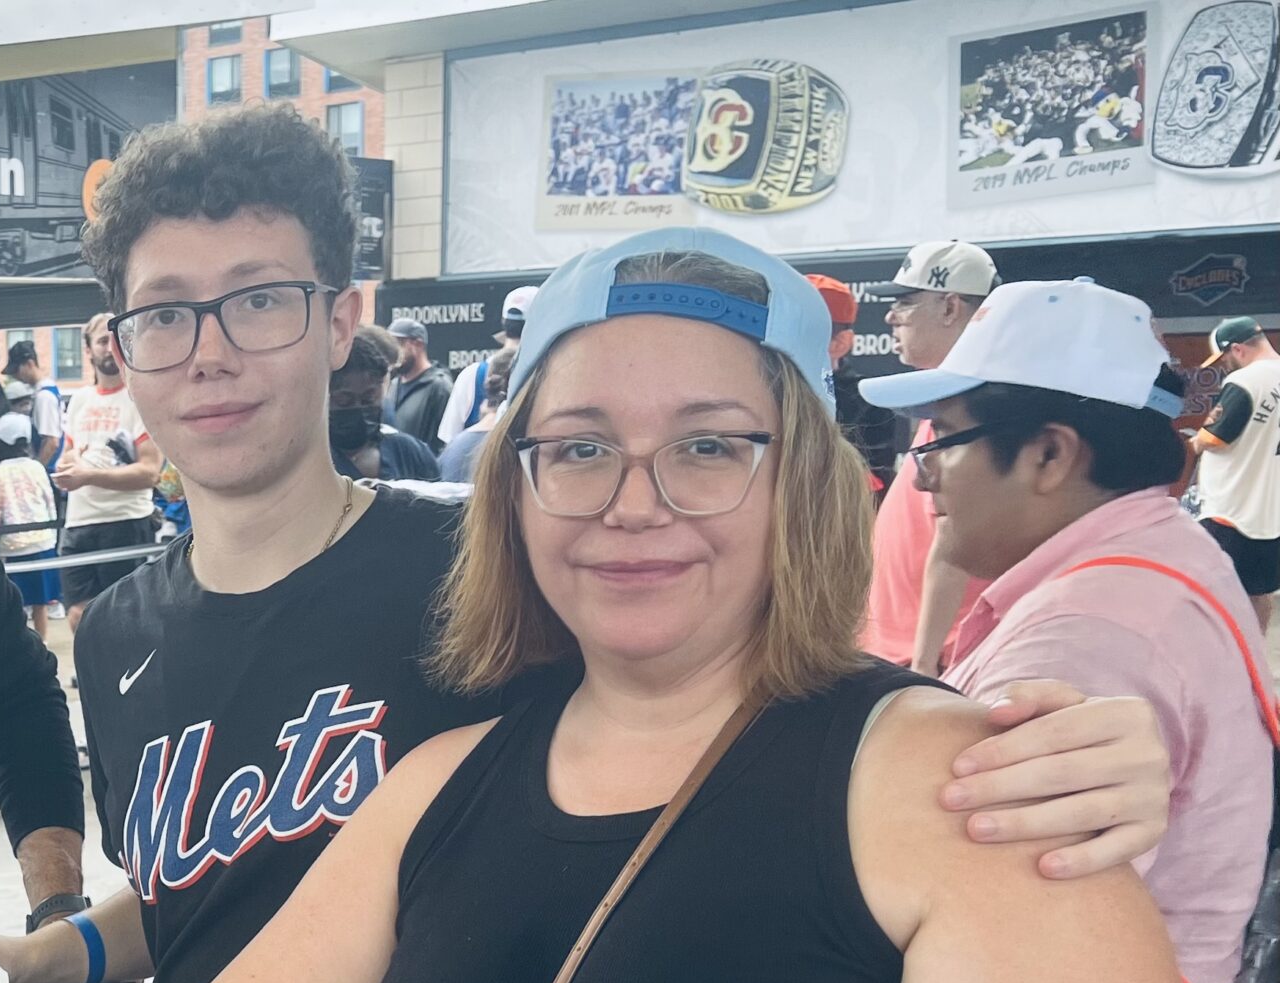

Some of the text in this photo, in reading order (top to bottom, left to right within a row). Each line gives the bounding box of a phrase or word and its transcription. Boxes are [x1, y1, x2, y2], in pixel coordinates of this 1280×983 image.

[793, 147, 819, 194] NEW
[807, 83, 828, 144] YORK
[972, 156, 1131, 193] 2019 NYPL Champs
[448, 349, 495, 370] BROO
[118, 683, 388, 906] Mets
